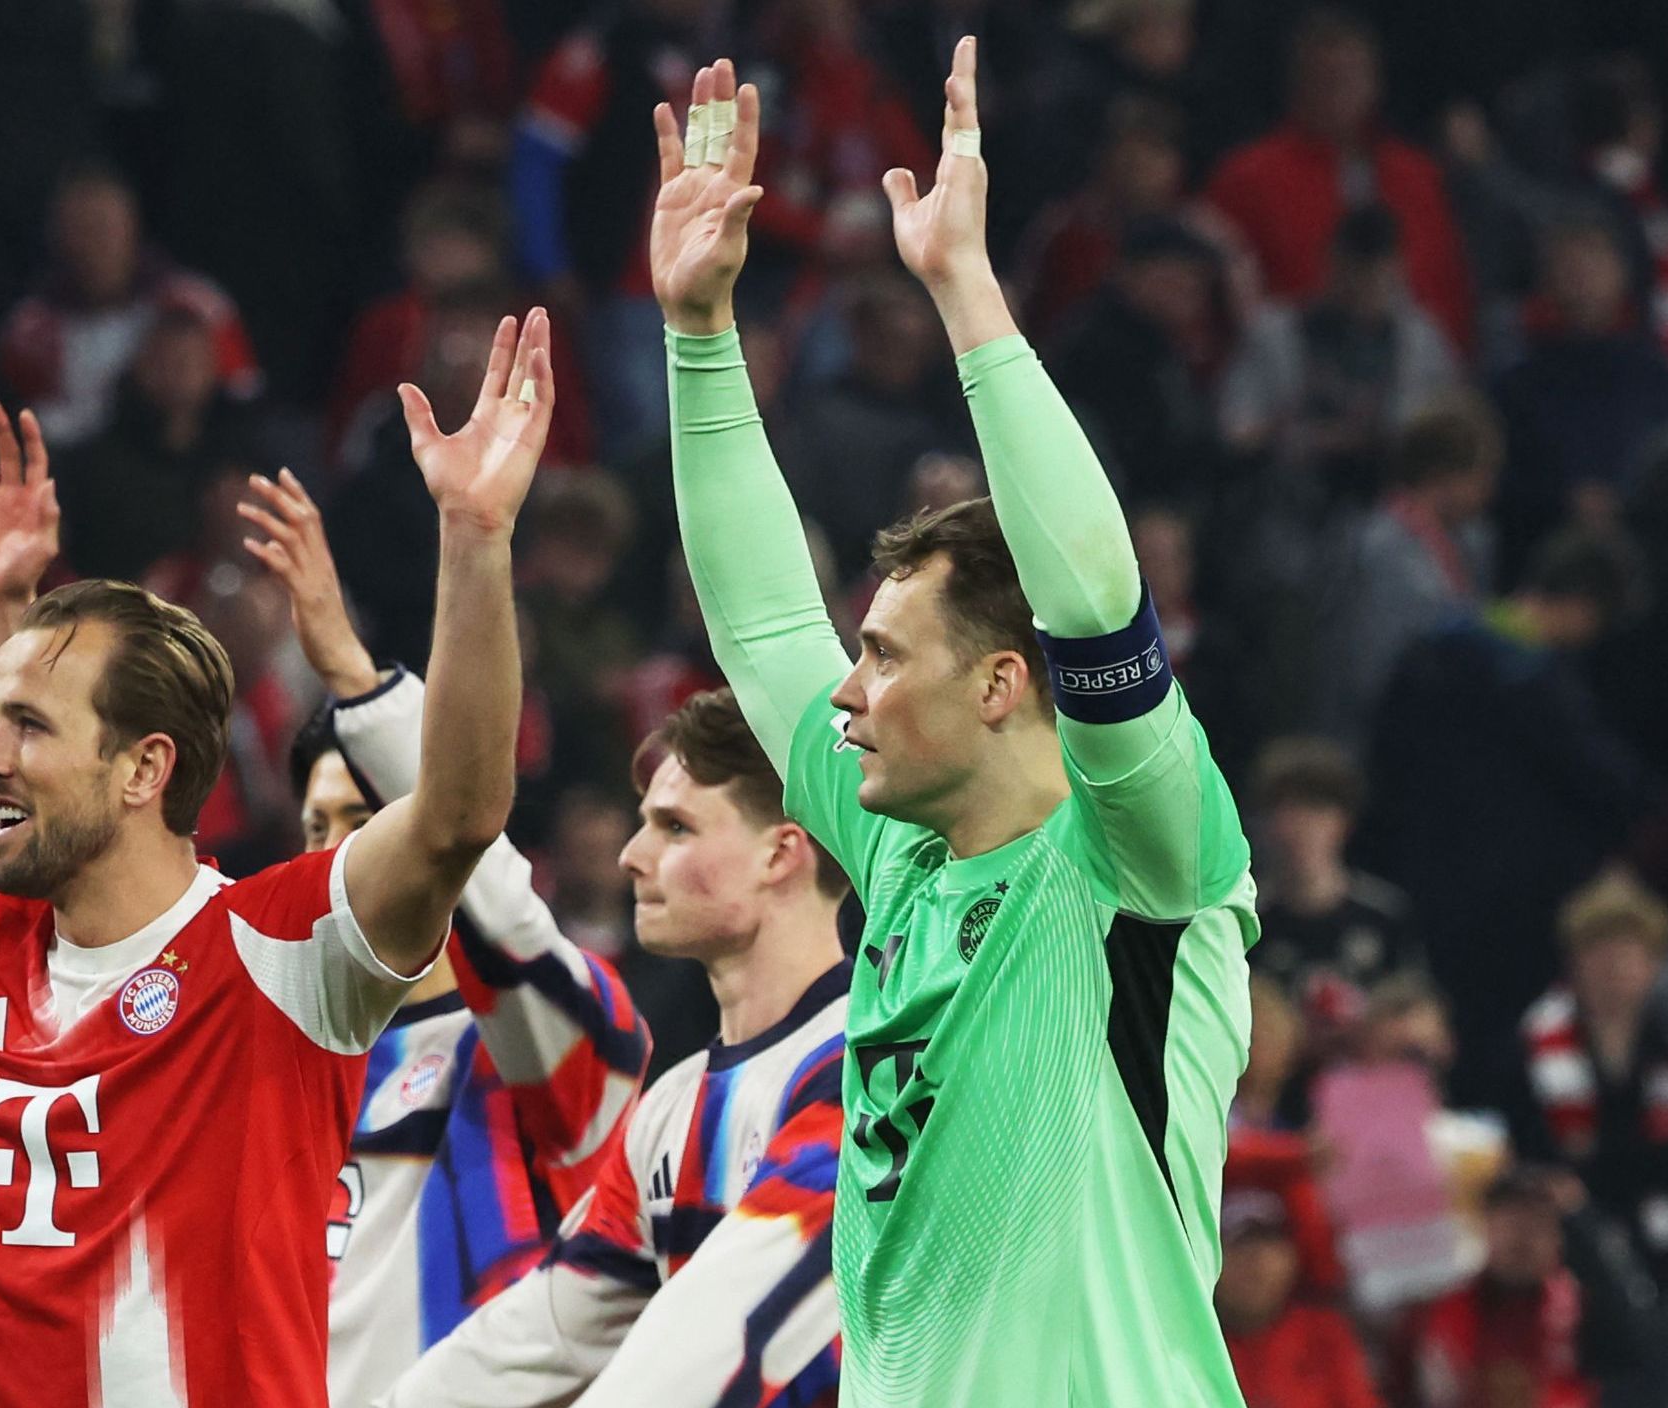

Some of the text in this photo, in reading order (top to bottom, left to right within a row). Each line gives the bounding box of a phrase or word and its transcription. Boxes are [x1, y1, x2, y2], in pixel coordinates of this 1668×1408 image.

[1059, 662, 1141, 689] RESPECT
[970, 903, 998, 920] BAYE
[124, 973, 176, 1004] FC BAYERN
